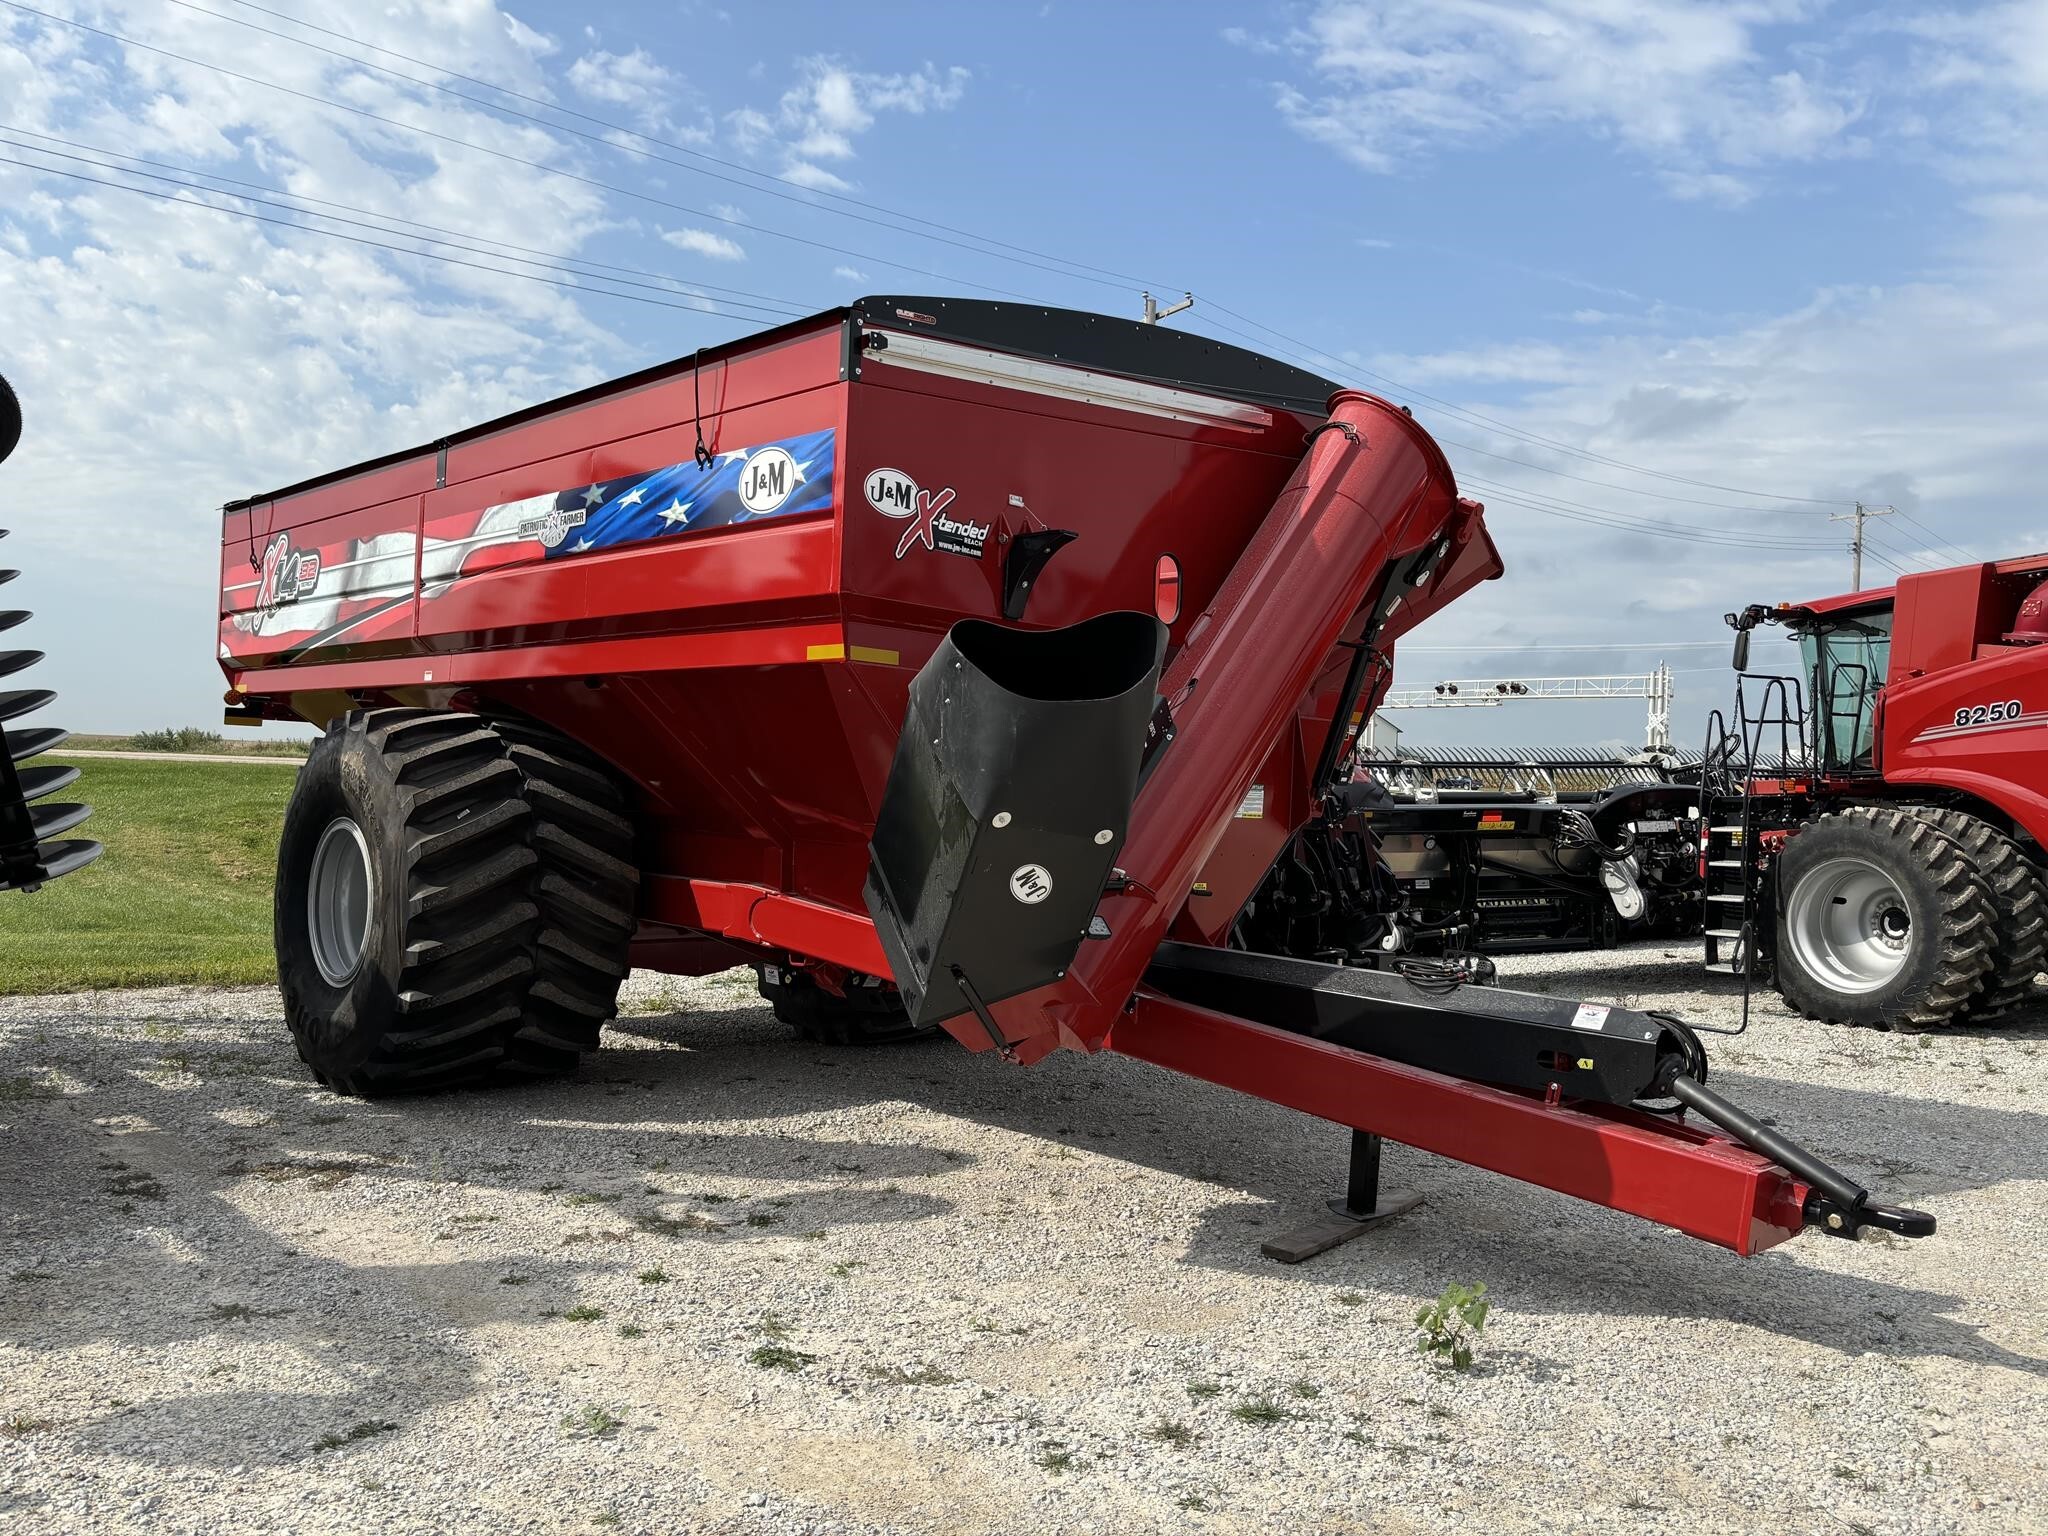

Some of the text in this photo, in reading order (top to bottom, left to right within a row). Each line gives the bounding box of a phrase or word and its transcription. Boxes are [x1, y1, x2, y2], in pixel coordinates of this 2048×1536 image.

[745, 460, 785, 500] J&M
[870, 477, 913, 510] J&M
[520, 511, 584, 534] PATRIOTIC FARMER
[963, 537, 983, 547] REACH
[1954, 700, 2022, 727] 8250
[1014, 867, 1048, 898] J&M
